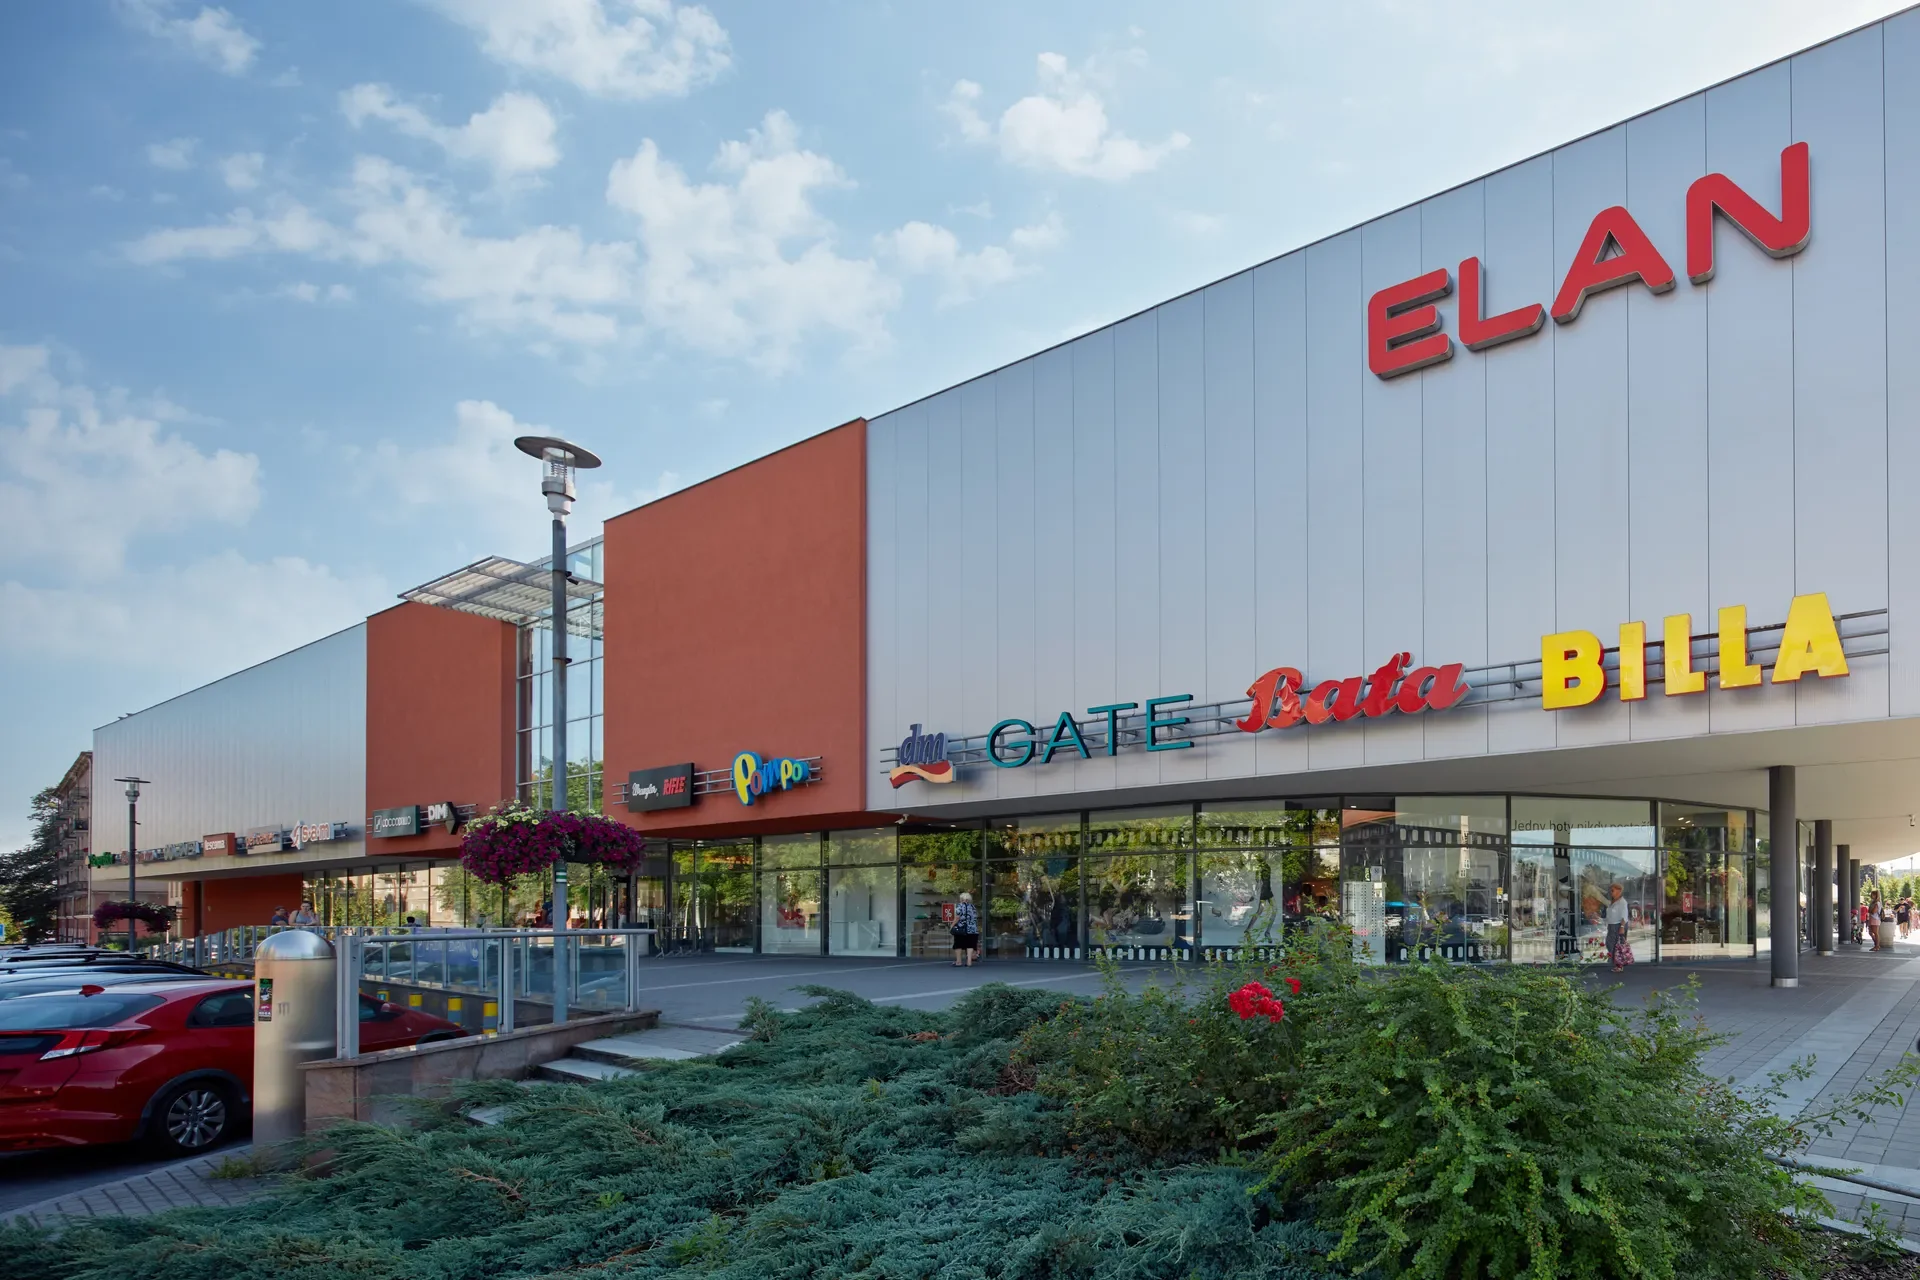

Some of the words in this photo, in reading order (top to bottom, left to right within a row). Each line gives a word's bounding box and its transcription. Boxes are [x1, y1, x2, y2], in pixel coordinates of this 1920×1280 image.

[1368, 141, 1811, 380] ELAN
[1542, 592, 1851, 711] BILLA
[899, 723, 949, 766] dm
[986, 694, 1195, 769] GATE
[632, 783, 658, 799] Wrangler
[663, 776, 686, 795] RIFLE
[427, 803, 449, 821] DIM
[1511, 820, 1547, 834] Jedny
[1549, 820, 1574, 835] boty
